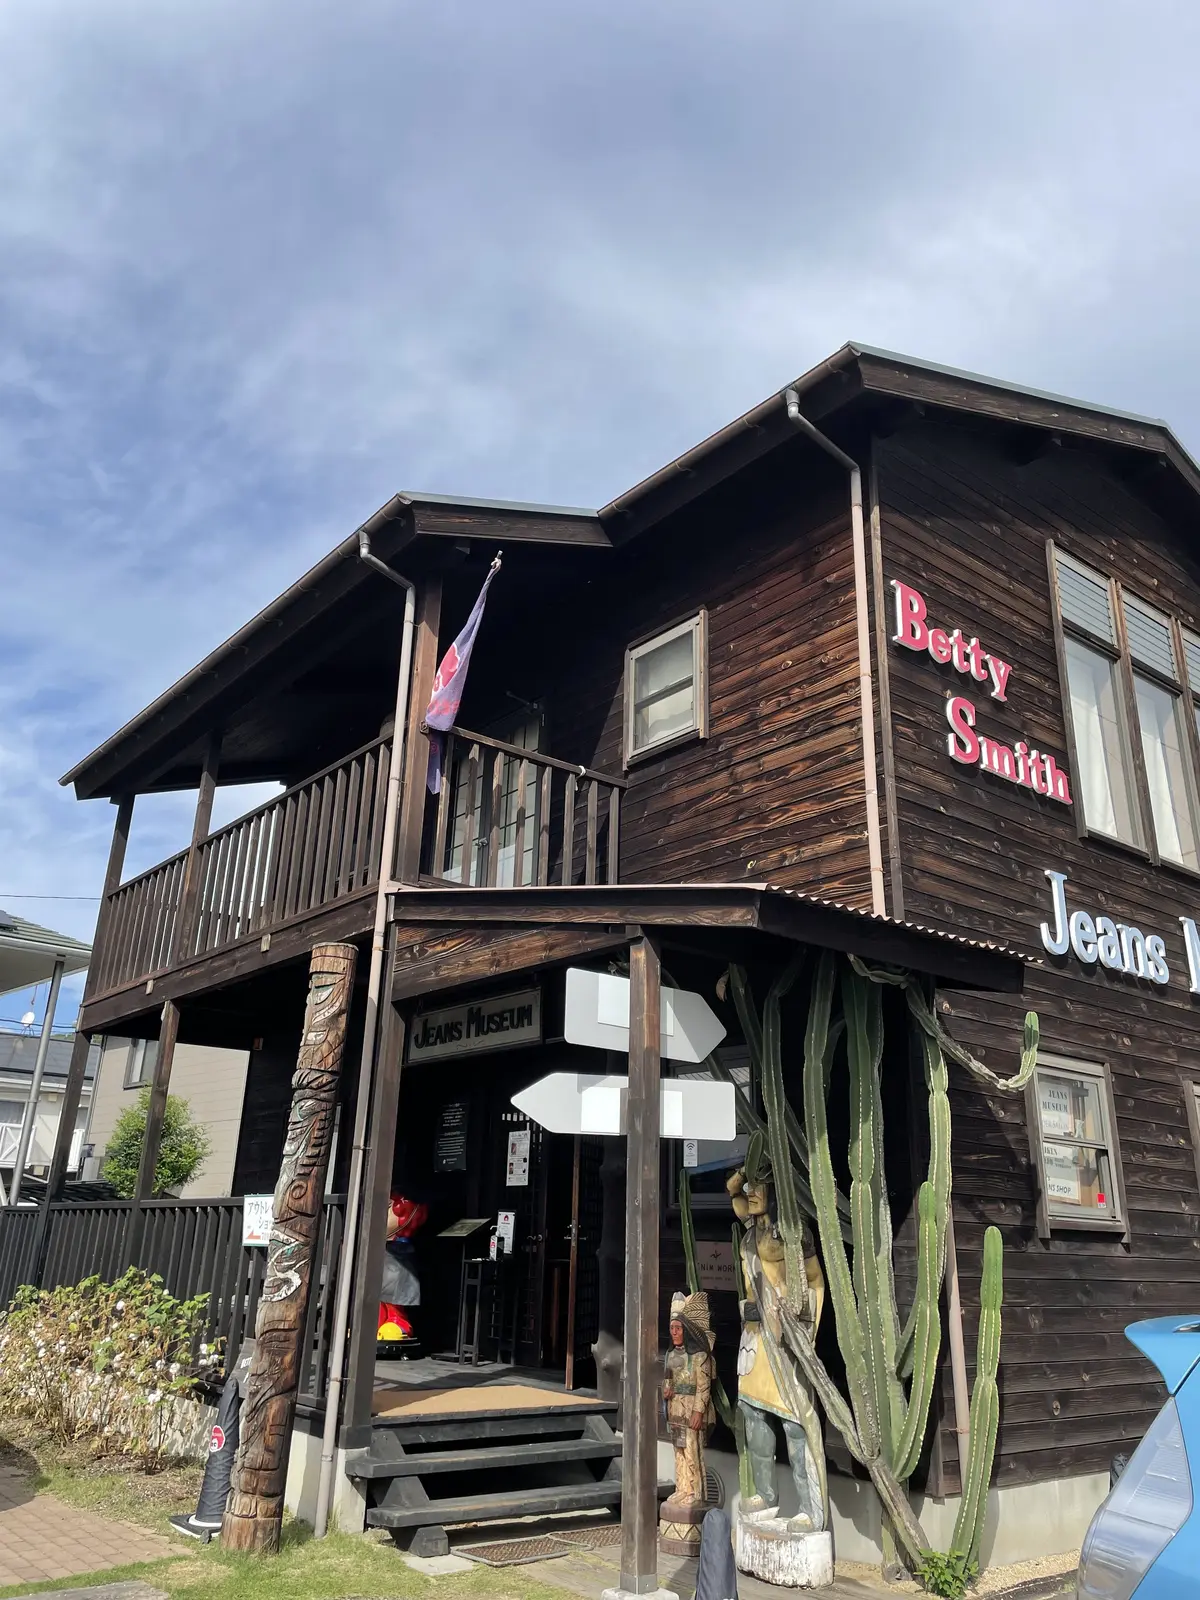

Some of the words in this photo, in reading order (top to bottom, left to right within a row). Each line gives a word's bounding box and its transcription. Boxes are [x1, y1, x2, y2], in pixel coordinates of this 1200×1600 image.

[889, 579, 1013, 702] Betty
[945, 696, 1073, 806] Smith
[1040, 870, 1169, 984] Jeans
[414, 1019, 462, 1049] JEANS
[466, 1004, 533, 1039] MUSEUM
[1042, 1101, 1068, 1113] MUSEUM
[1048, 1089, 1068, 1100] JEANS
[1056, 1185, 1072, 1194] SHOP
[248, 1201, 272, 1216] アウトレ
